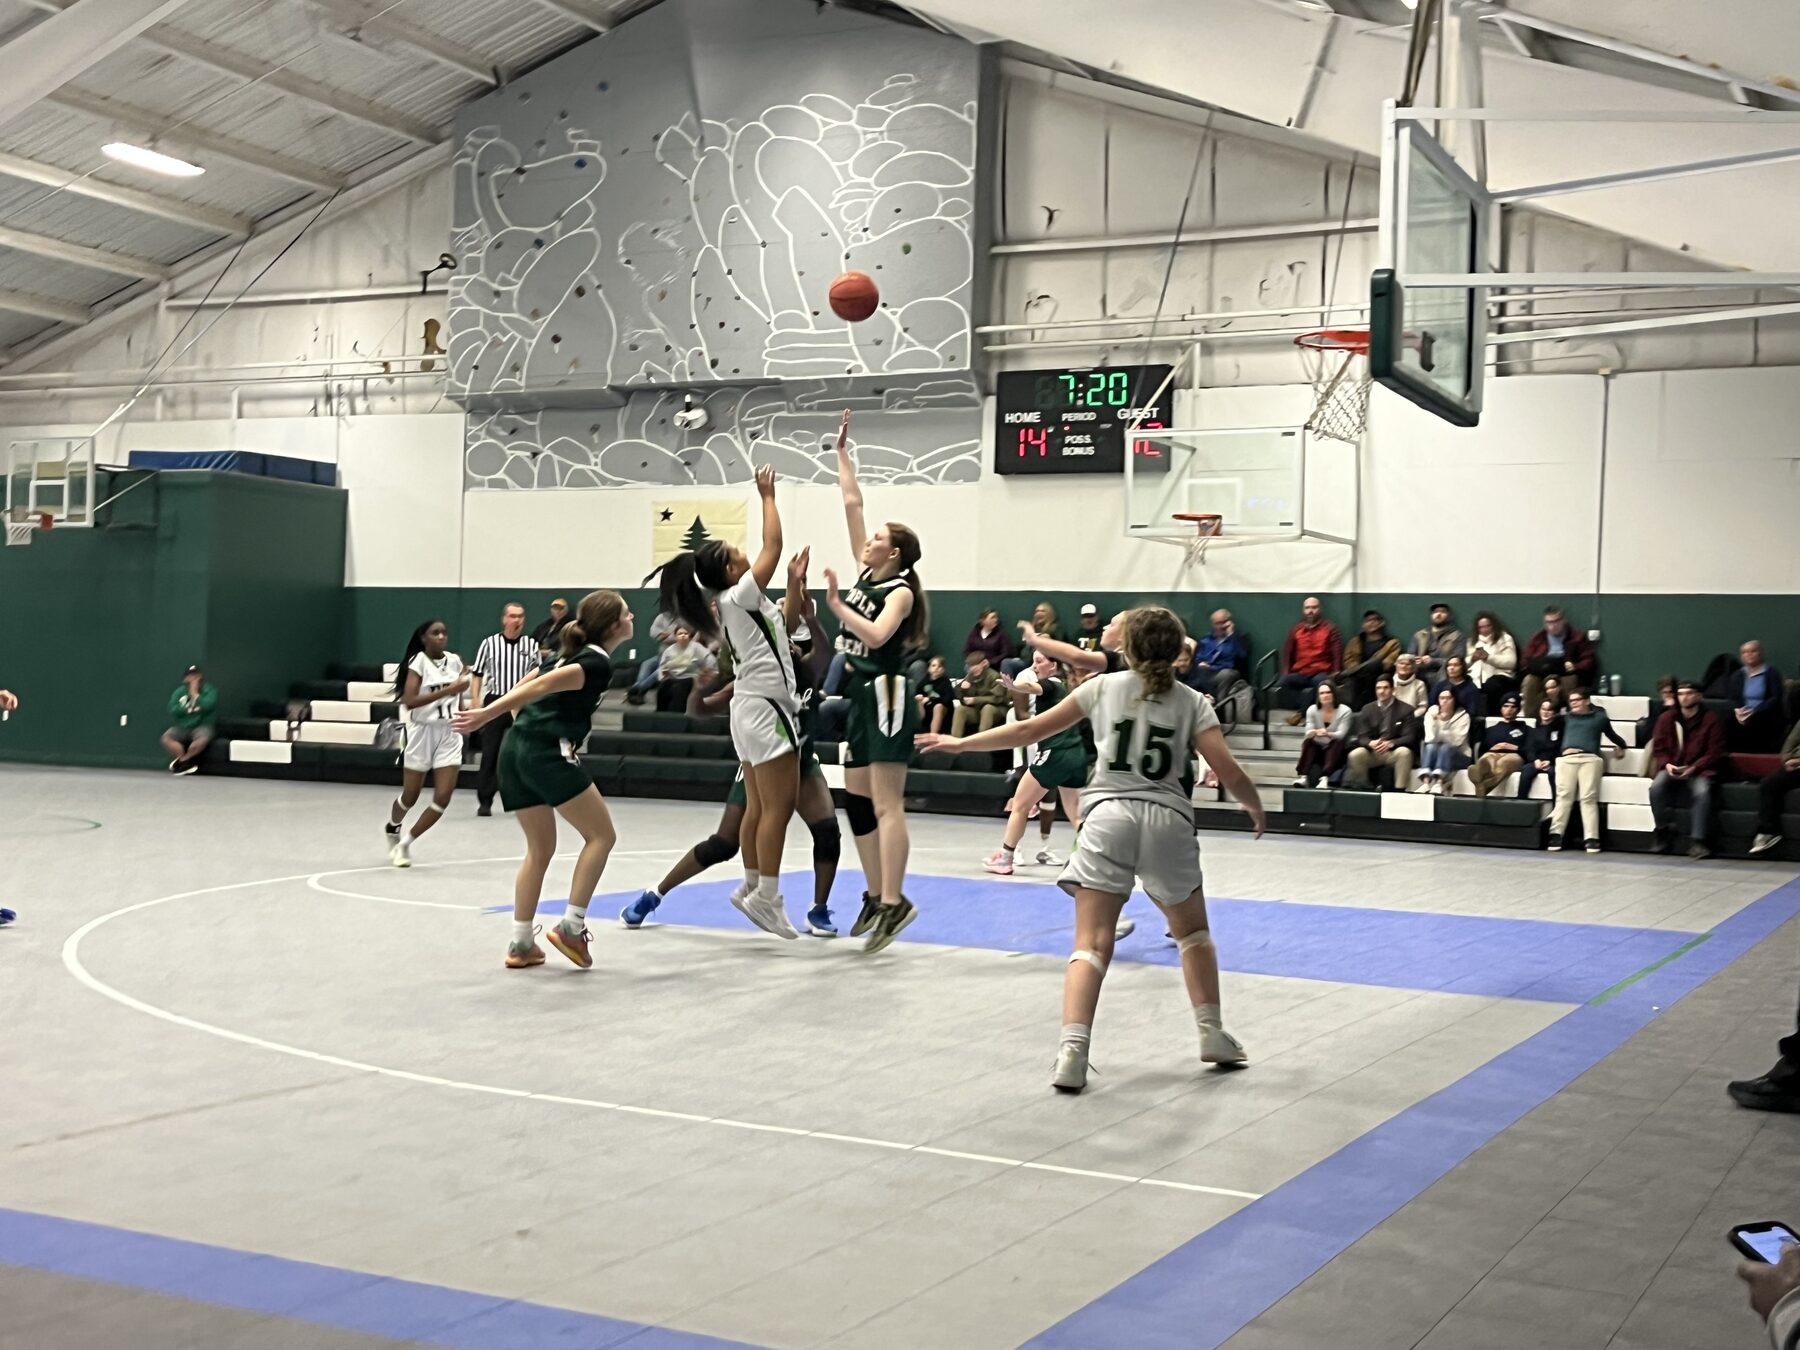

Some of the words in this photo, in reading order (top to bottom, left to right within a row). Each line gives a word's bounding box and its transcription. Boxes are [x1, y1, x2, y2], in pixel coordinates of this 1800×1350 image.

[1058, 372, 1128, 406] 7:20
[1004, 411, 1042, 424] HOME
[1061, 411, 1097, 422] PERIOD
[1116, 407, 1160, 420] GUEST
[1018, 427, 1048, 457] 14
[1062, 446, 1095, 456] BONUS
[1106, 716, 1177, 781] 15
